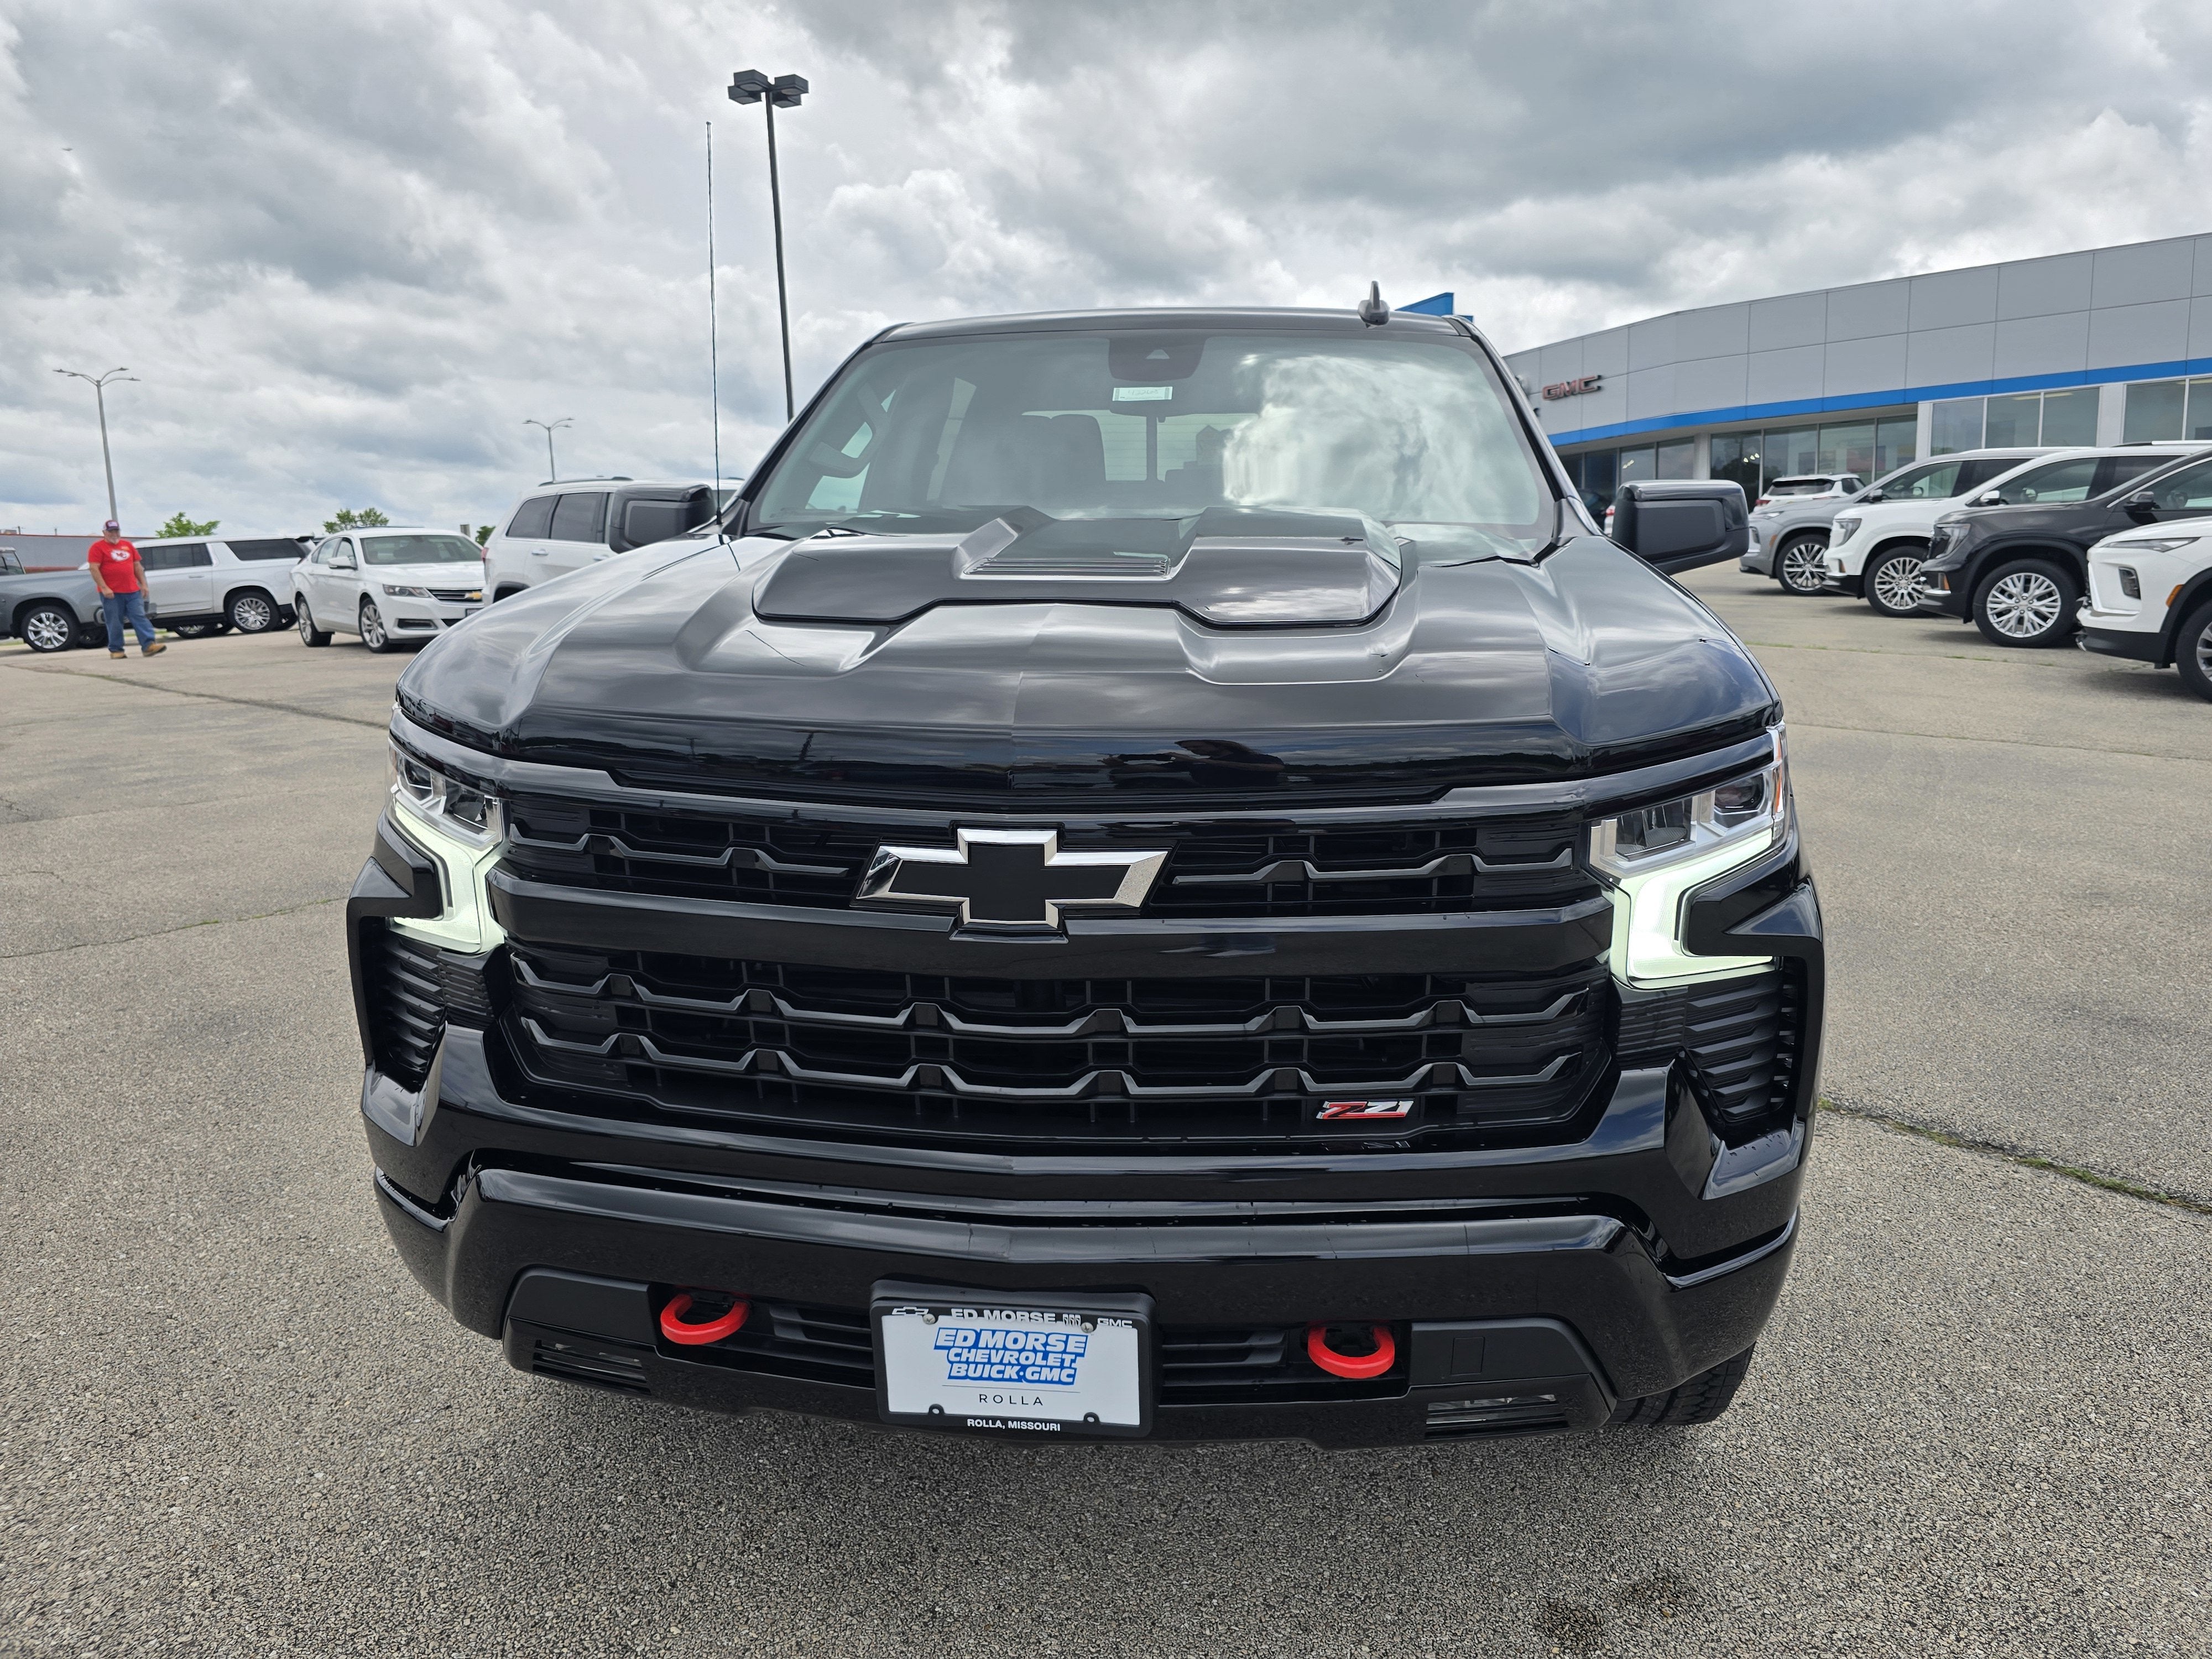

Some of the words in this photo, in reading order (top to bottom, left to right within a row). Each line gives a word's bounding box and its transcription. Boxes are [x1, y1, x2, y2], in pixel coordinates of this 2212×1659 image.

[1542, 375, 1600, 400] GMC
[1316, 1101, 1413, 1119] Z71
[951, 1308, 978, 1320] ED
[983, 1310, 1056, 1324] MORSE
[1097, 1318, 1133, 1328] GMC
[936, 1329, 976, 1347] ED
[978, 1331, 1087, 1354] MORSE
[948, 1348, 1075, 1366] CHEVROLET
[979, 1394, 1043, 1406] ROLLA
[967, 1418, 1005, 1430] ROLLA,
[1008, 1421, 1061, 1431] MISSOURI
